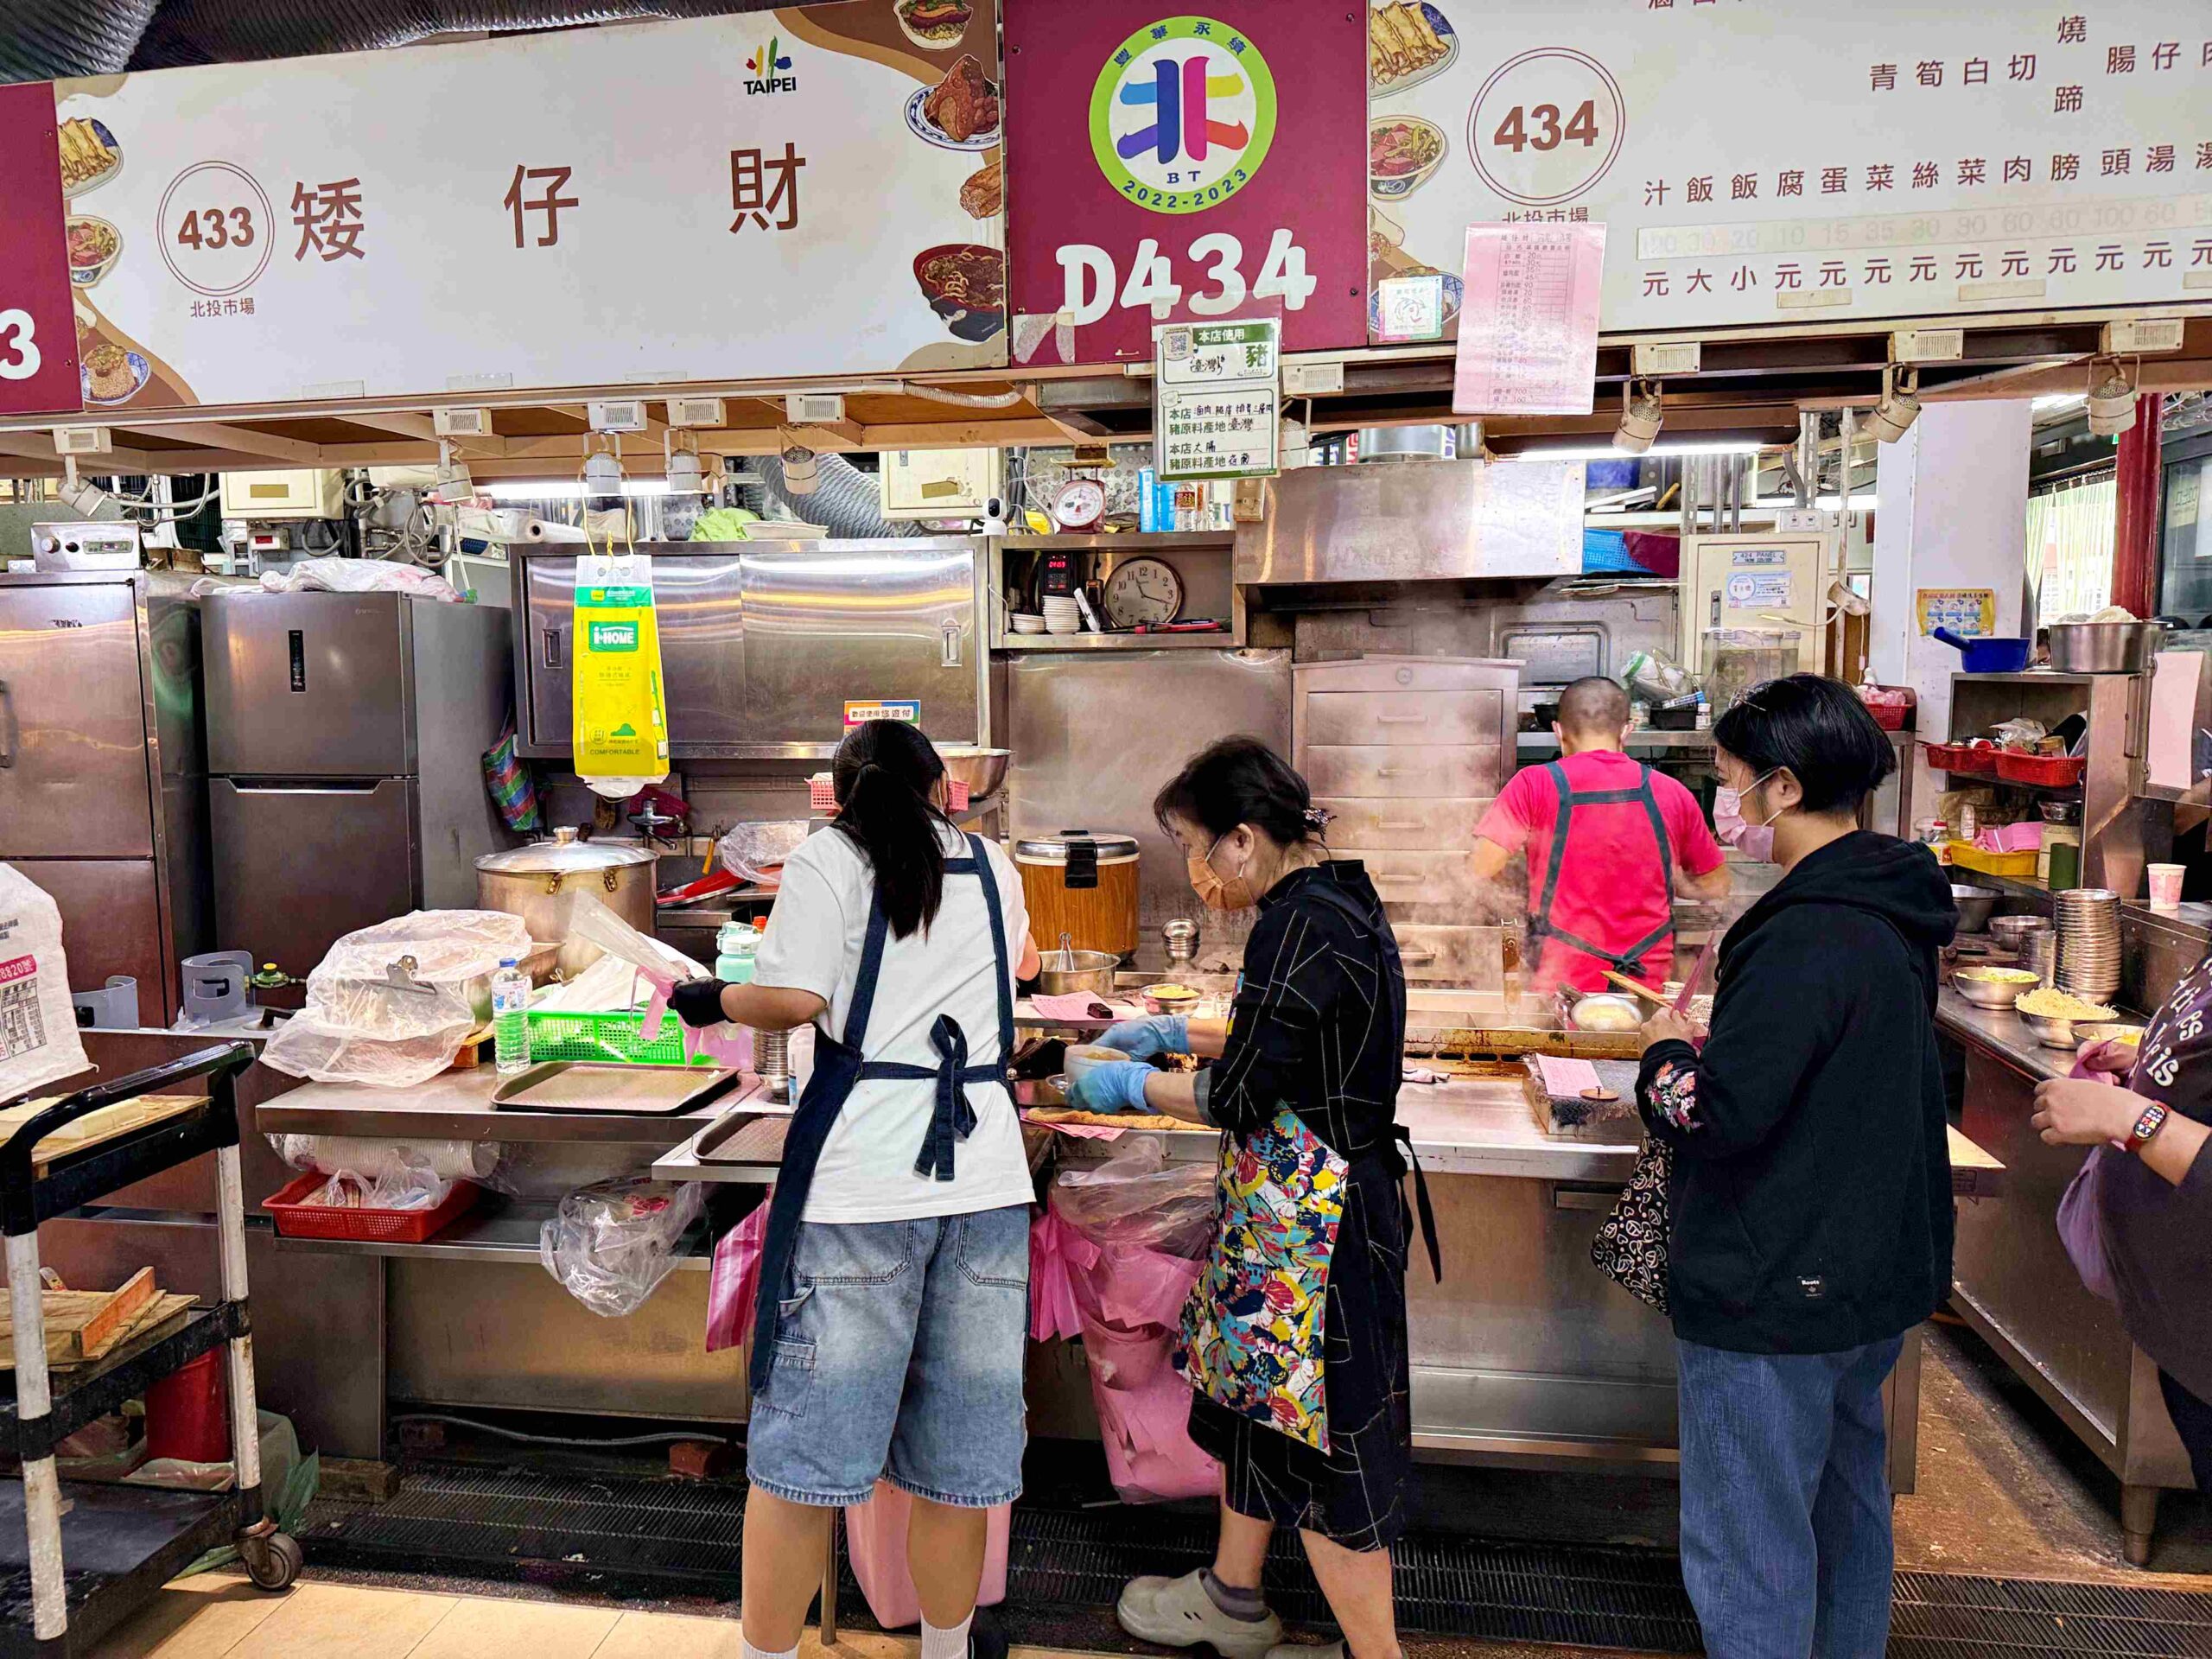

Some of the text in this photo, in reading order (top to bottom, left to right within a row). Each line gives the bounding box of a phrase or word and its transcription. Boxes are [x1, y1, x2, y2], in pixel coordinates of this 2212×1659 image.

[1113, 21, 1248, 68] 豐華永續
[743, 76, 798, 96] TAIPEI
[1494, 100, 1599, 154] 434
[1122, 168, 1248, 209] 2022-2023
[290, 143, 807, 263] 矮仔財
[178, 207, 255, 251] 433
[1055, 228, 1317, 327] D434
[189, 297, 256, 318] 北投市場
[0, 308, 41, 380] 3
[1198, 328, 1246, 343] 本店使用
[1245, 344, 1268, 369] 豬
[1169, 408, 1192, 421] 本店
[1169, 420, 1226, 435] 豬原料產地
[1169, 443, 1192, 455] 本店
[1169, 454, 1226, 470] 豬原料產地
